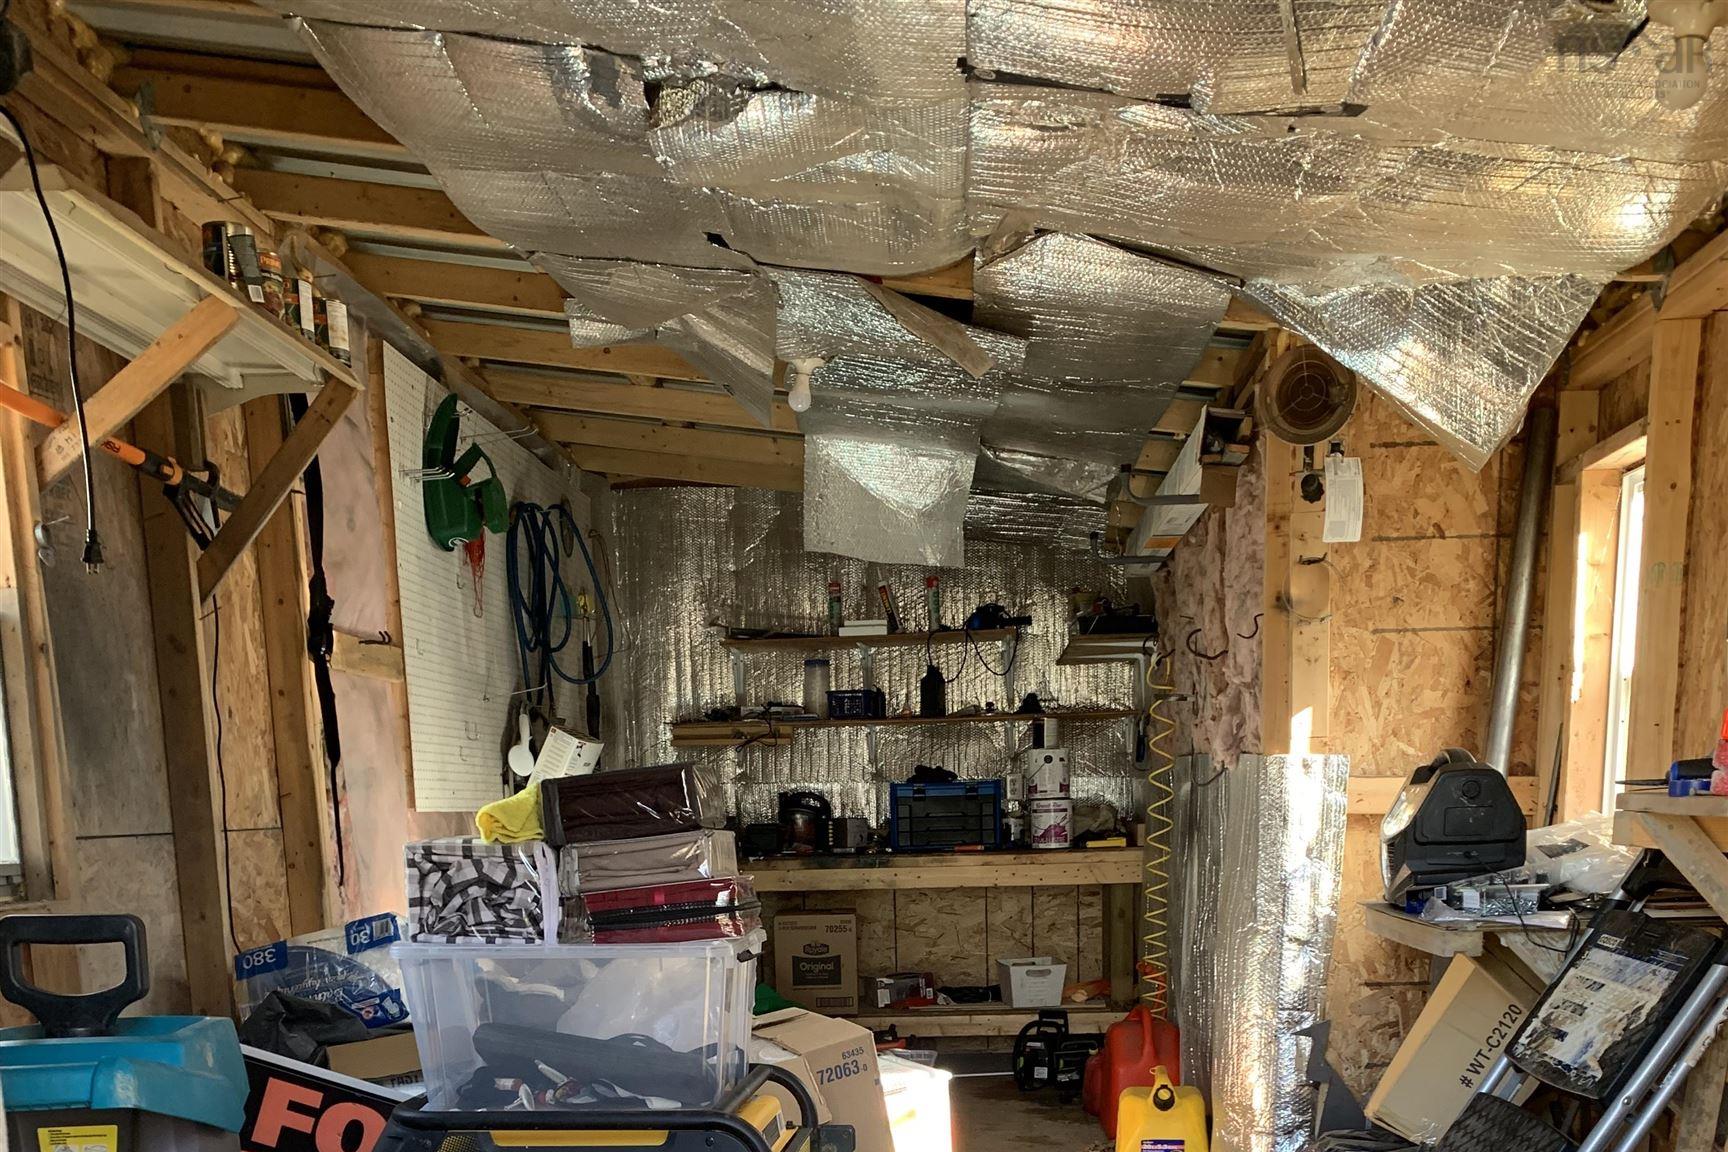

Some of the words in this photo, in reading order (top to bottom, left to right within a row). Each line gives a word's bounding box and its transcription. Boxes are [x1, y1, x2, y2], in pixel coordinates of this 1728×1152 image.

[242, 948, 277, 969] 380
[800, 961, 834, 974] Original
[1466, 1003, 1522, 1075] WT-C2120
